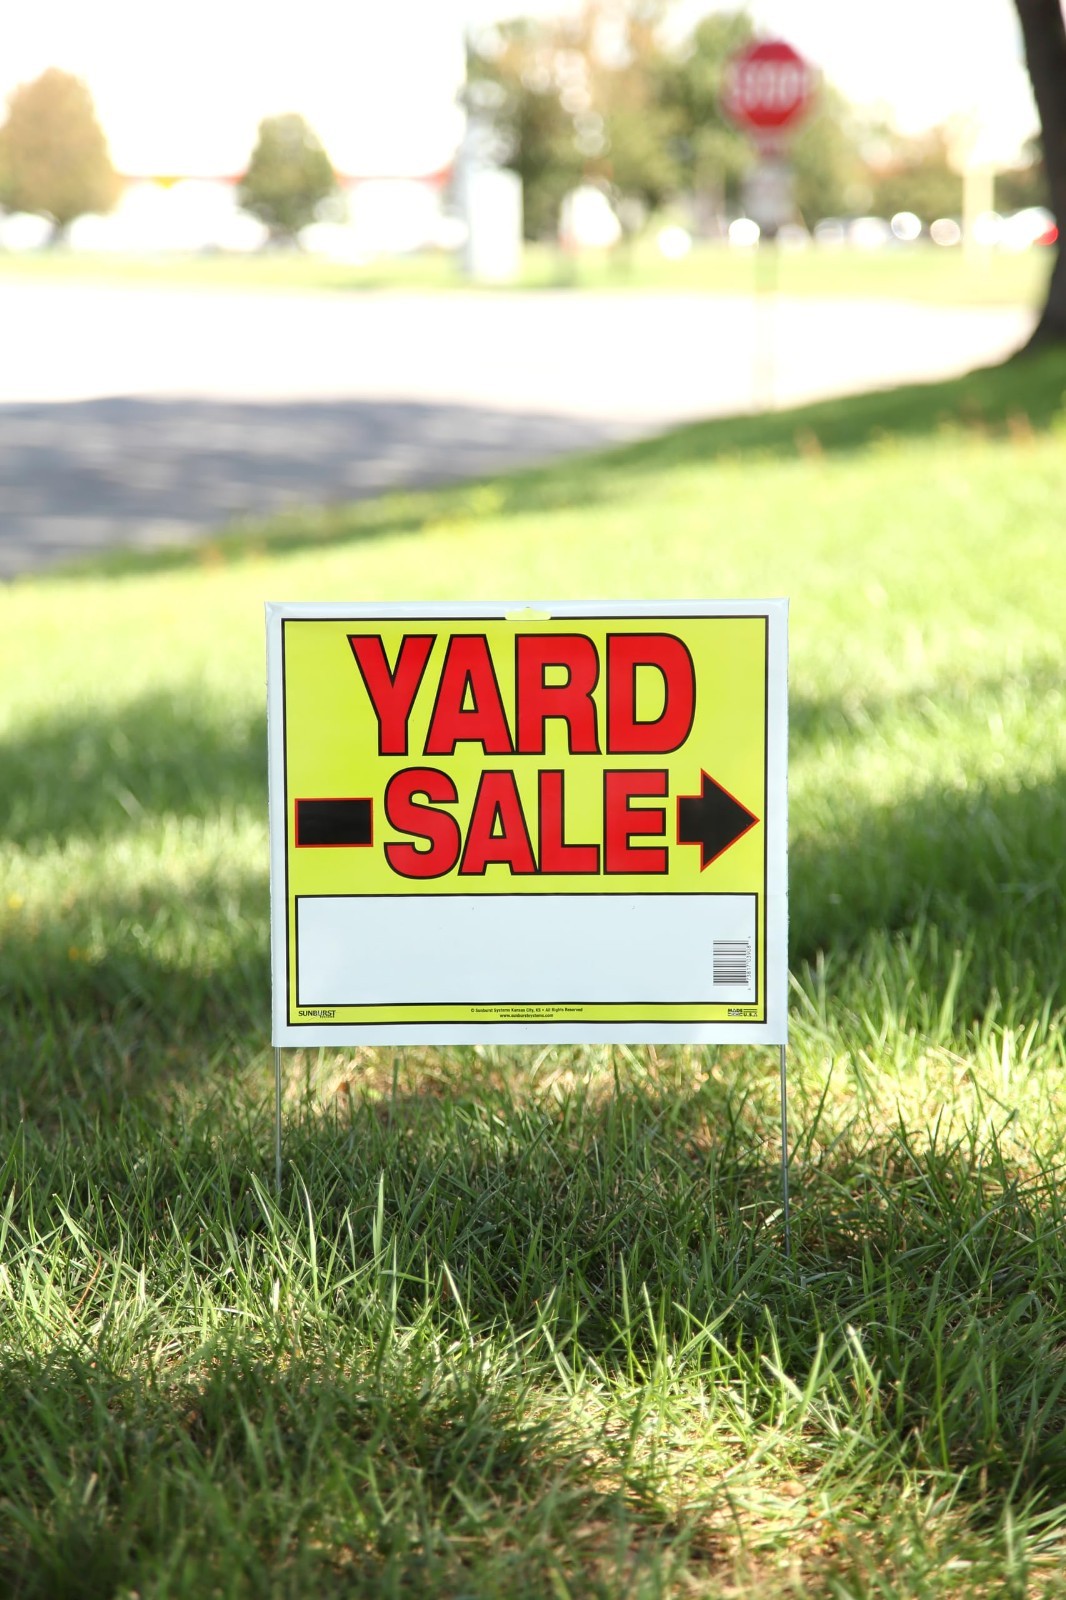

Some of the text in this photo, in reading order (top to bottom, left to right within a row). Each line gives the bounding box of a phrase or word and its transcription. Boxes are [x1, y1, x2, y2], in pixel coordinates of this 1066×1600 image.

[346, 632, 697, 757] YARD
[383, 766, 669, 880] SALE
[298, 1010, 336, 1018] SUNBURST
